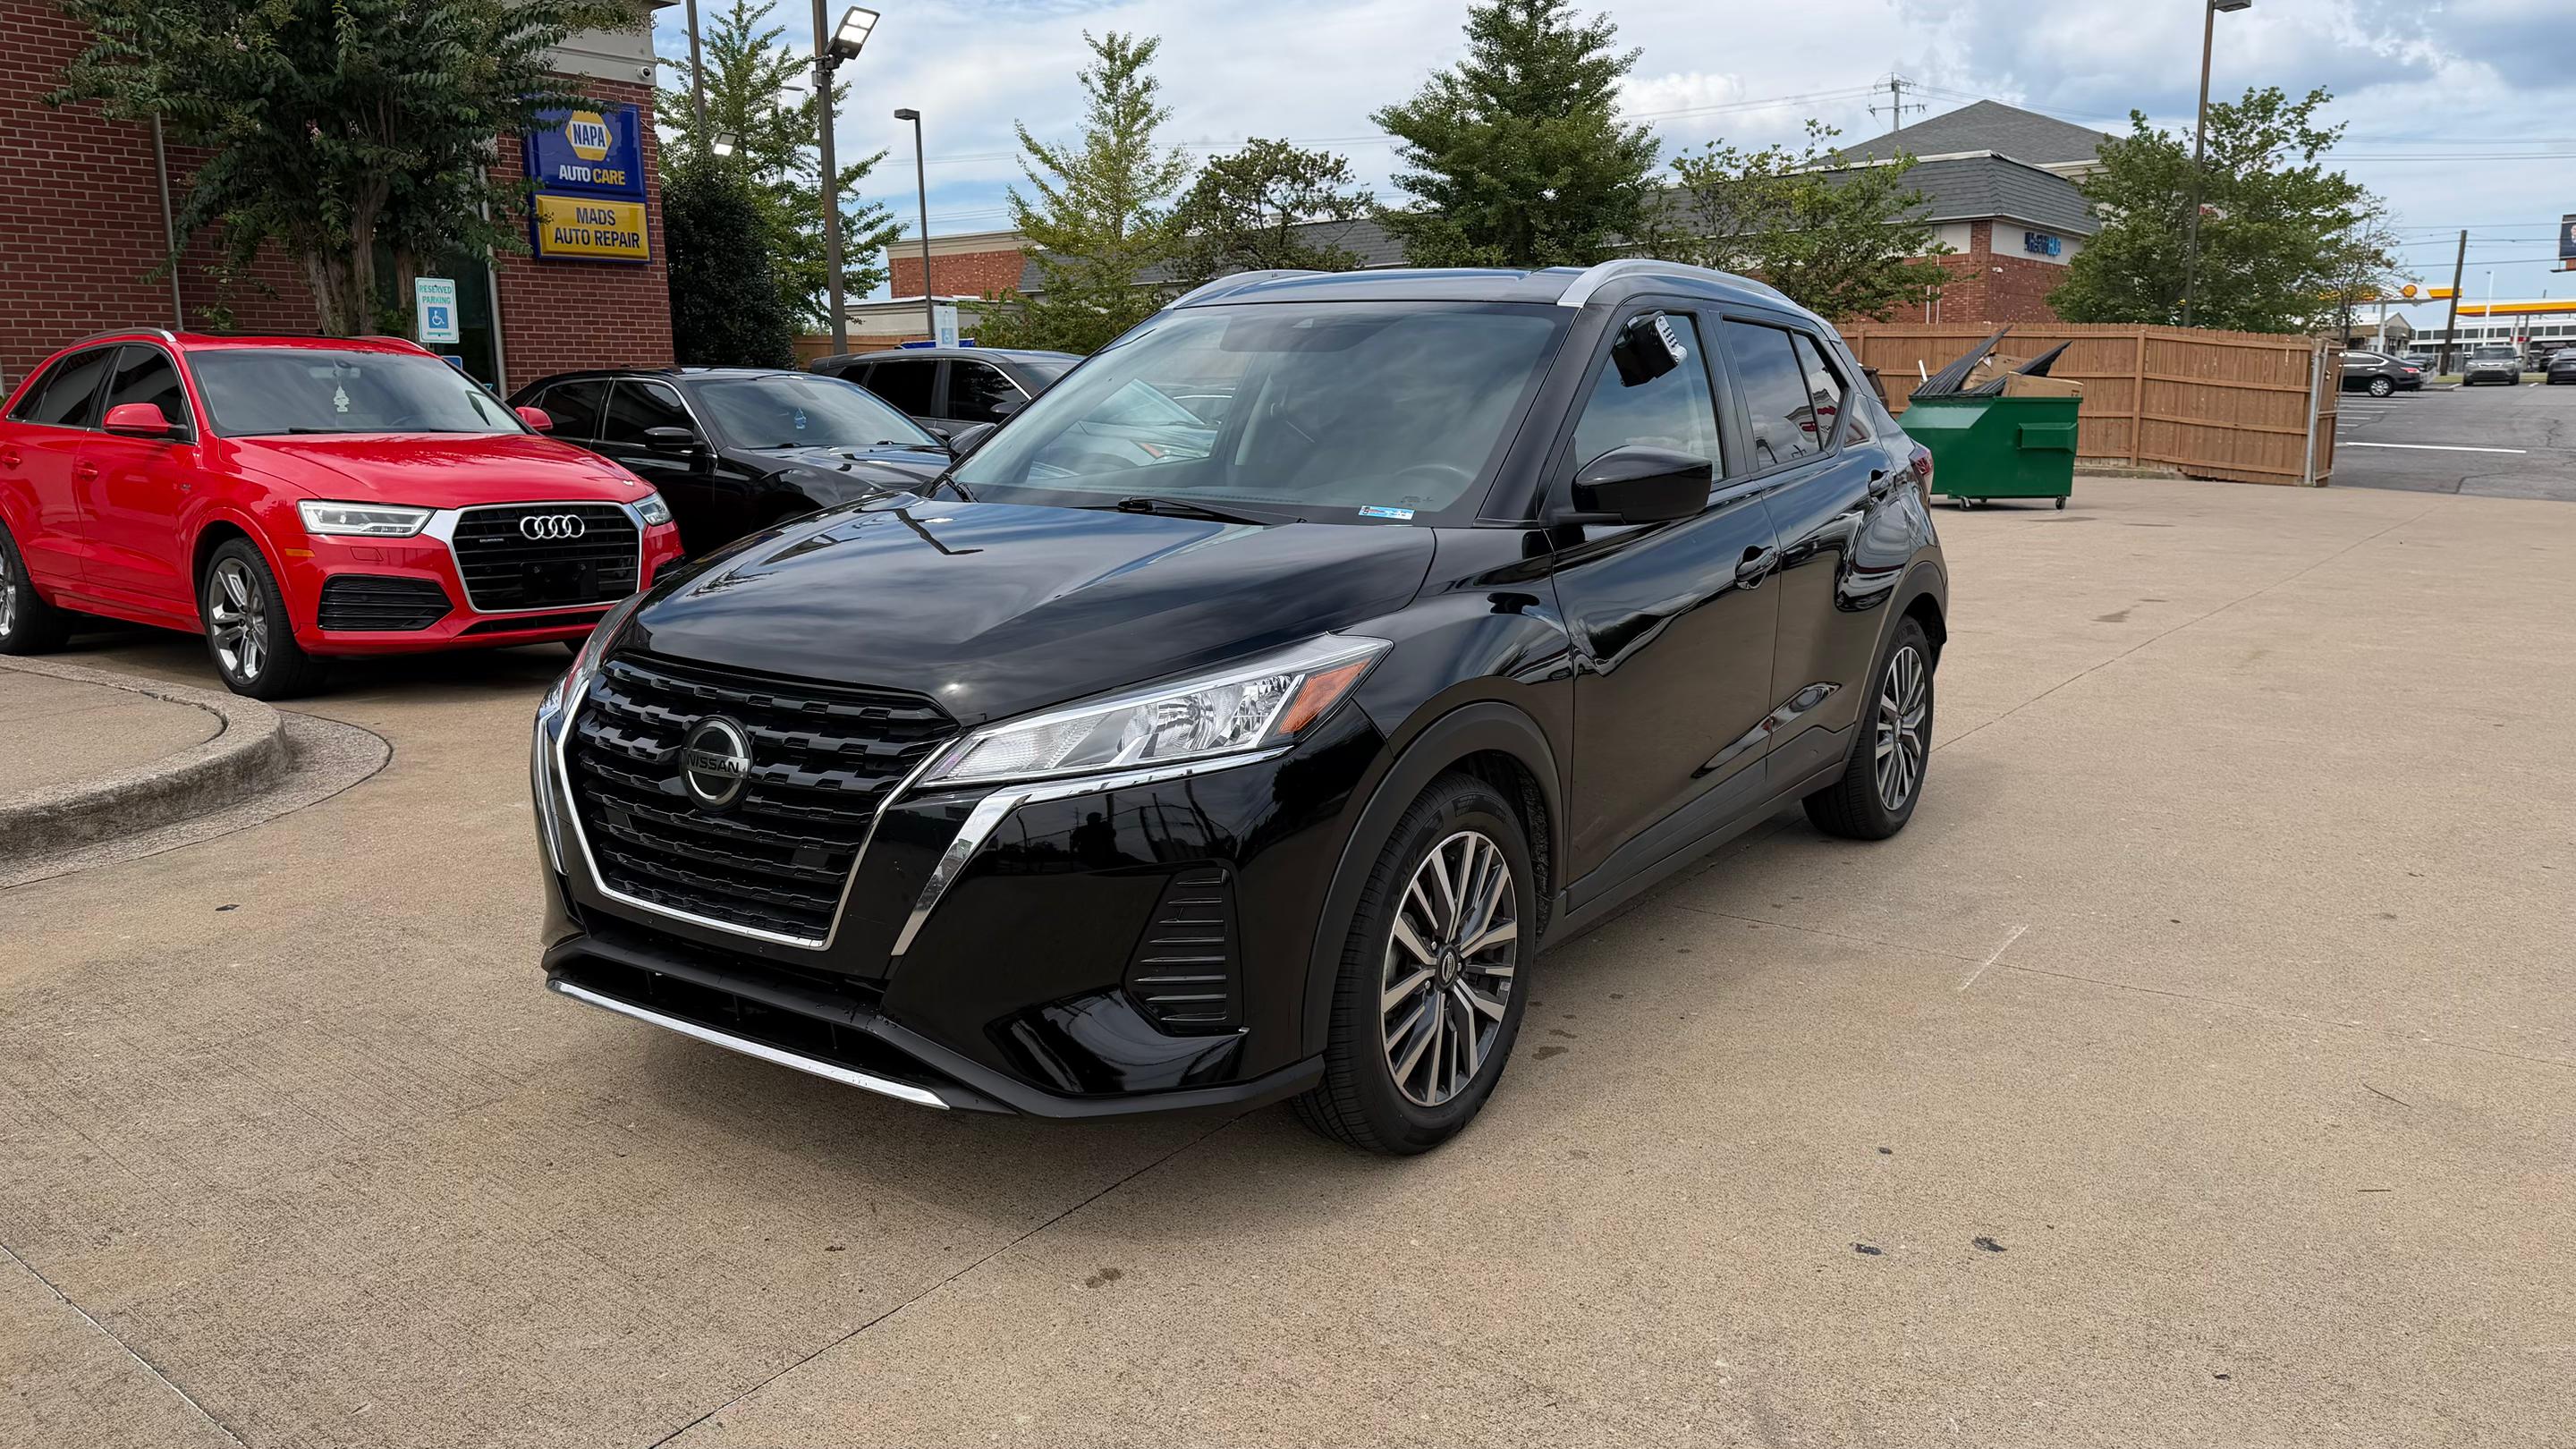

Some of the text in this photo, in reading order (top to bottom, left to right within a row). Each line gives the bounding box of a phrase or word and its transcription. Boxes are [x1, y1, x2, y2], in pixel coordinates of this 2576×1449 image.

[572, 123, 606, 148] NAPA
[559, 165, 625, 185] AUTO CARE
[576, 207, 615, 225] MADS
[555, 227, 640, 249] AUTO REPAIR
[419, 285, 452, 293] RESERVED
[422, 296, 451, 304] PARKING
[687, 753, 739, 773] NISSAN
